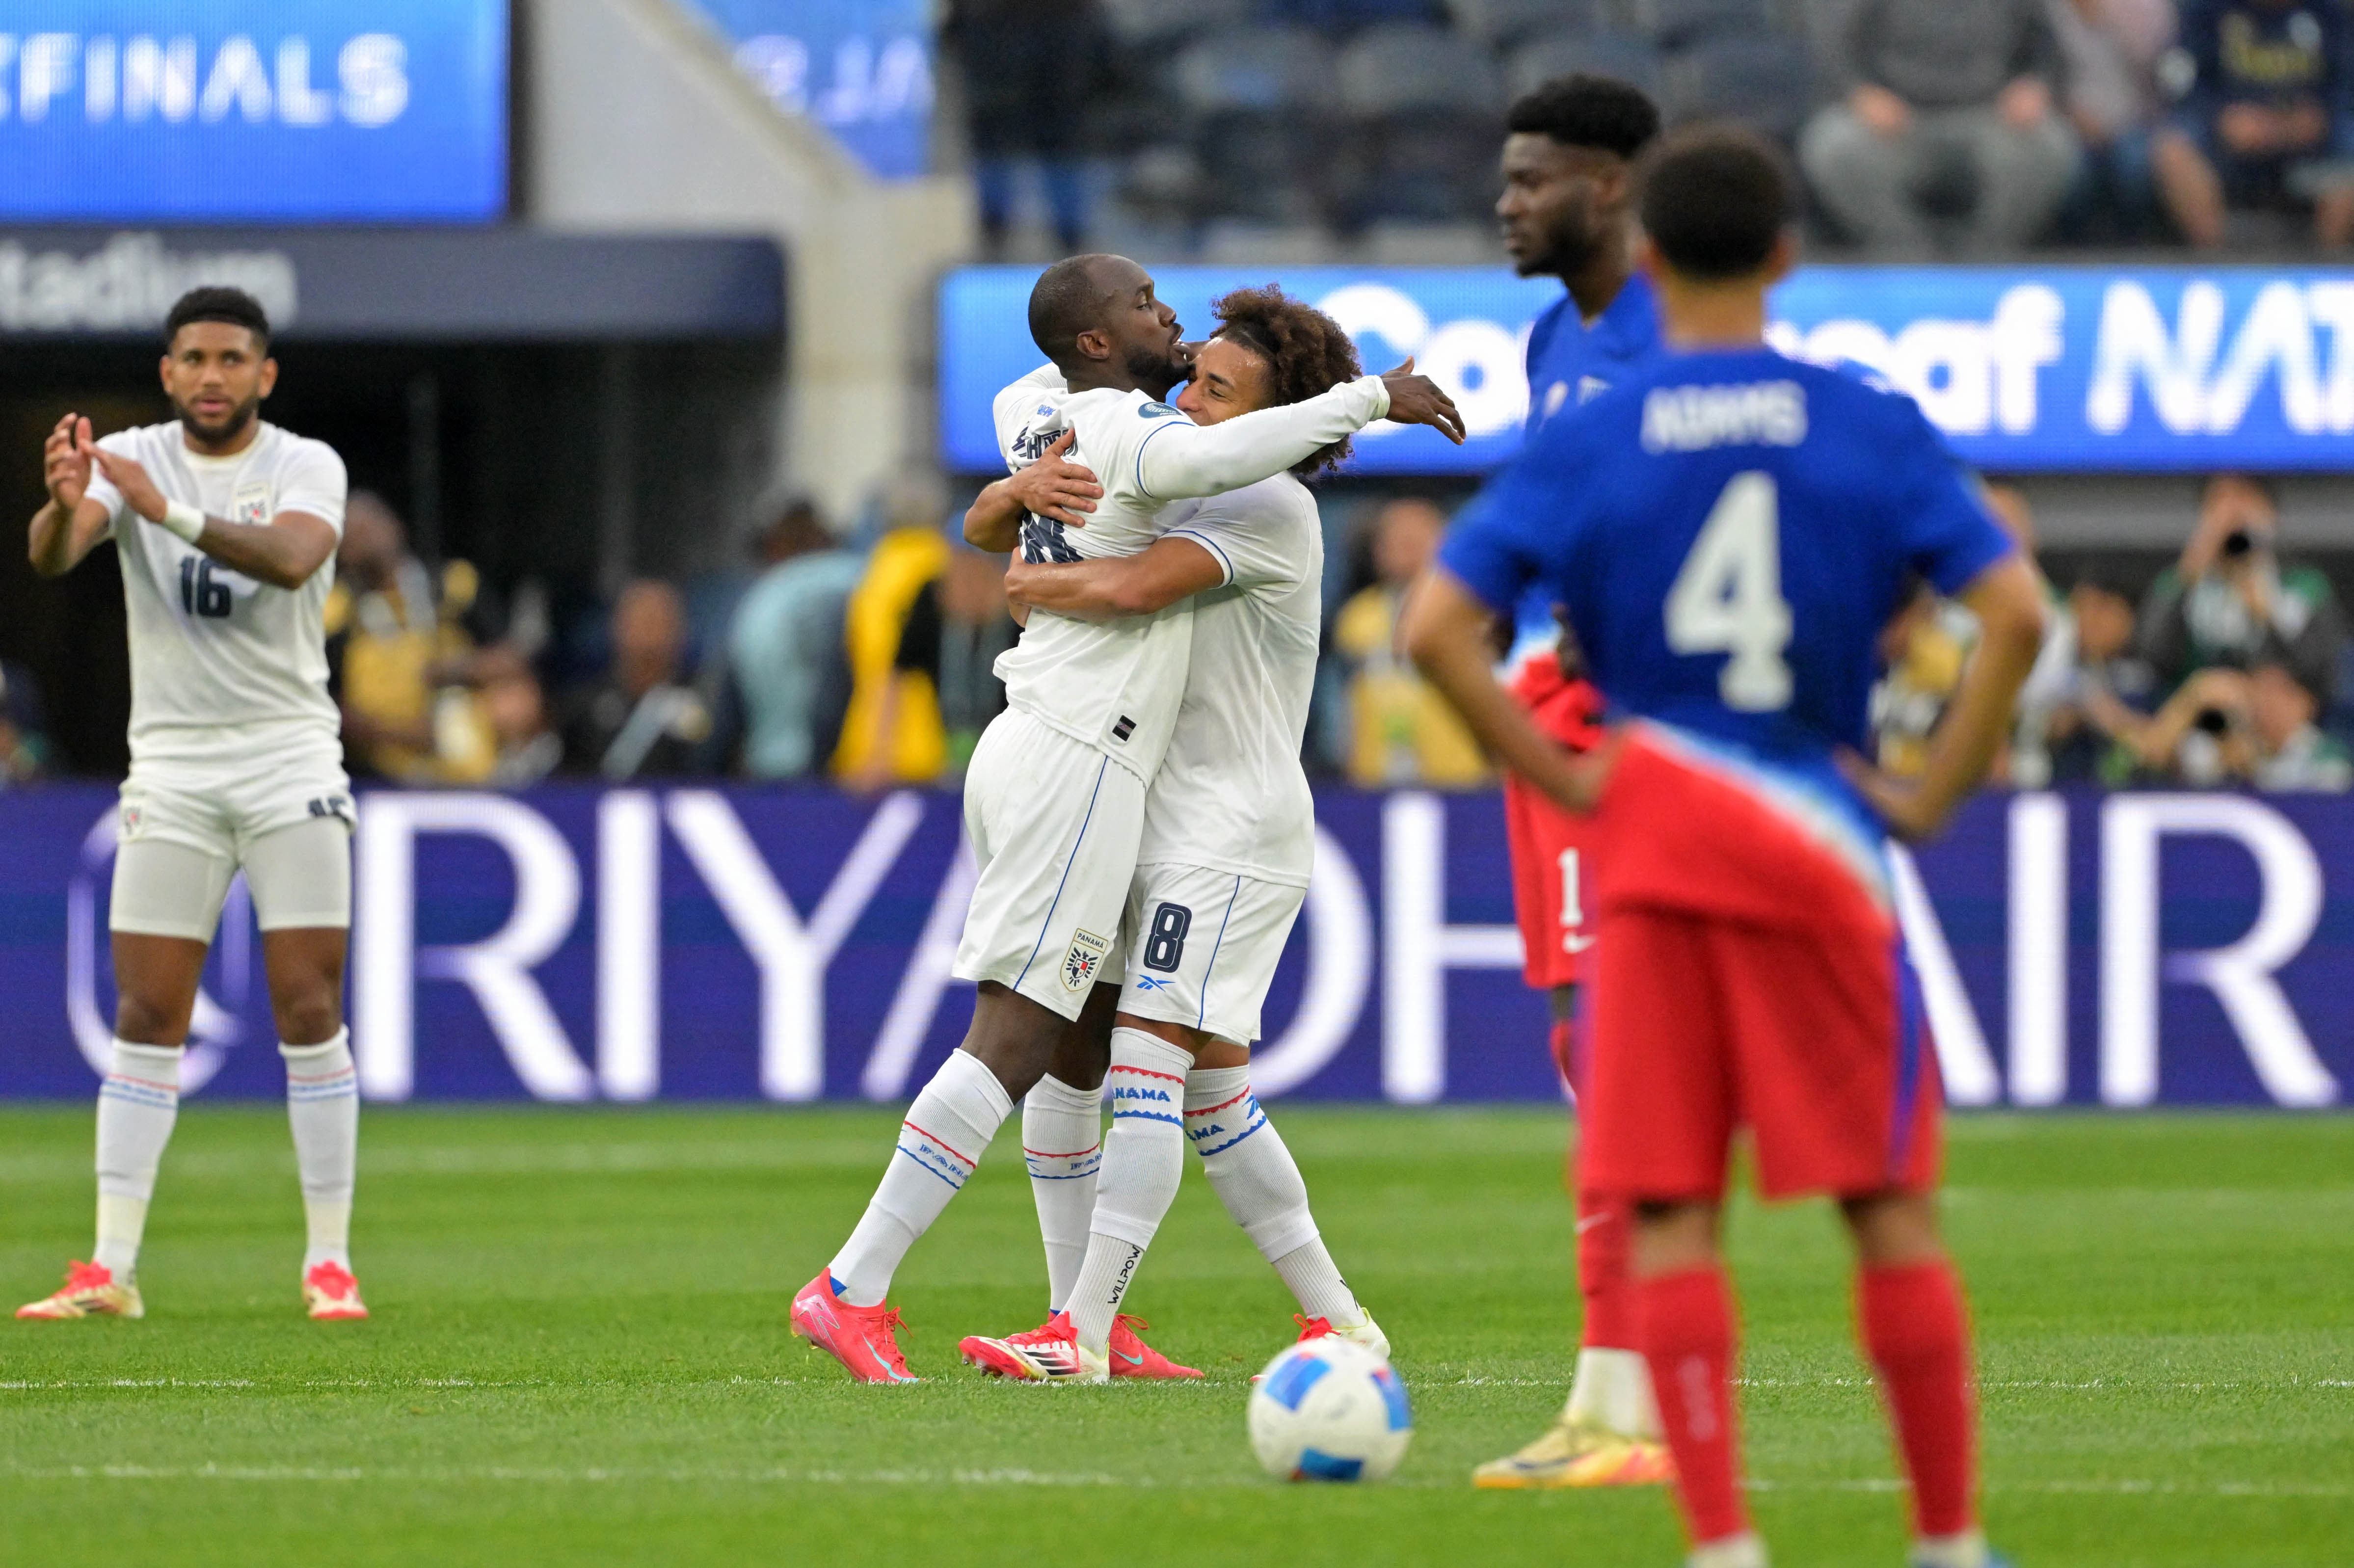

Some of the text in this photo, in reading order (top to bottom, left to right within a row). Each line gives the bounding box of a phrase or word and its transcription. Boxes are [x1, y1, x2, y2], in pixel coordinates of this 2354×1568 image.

[181, 556, 231, 617] 16
[1663, 470, 1794, 712] 4
[1143, 902, 1192, 973] 8
[1112, 1087, 1171, 1102] NAMA
